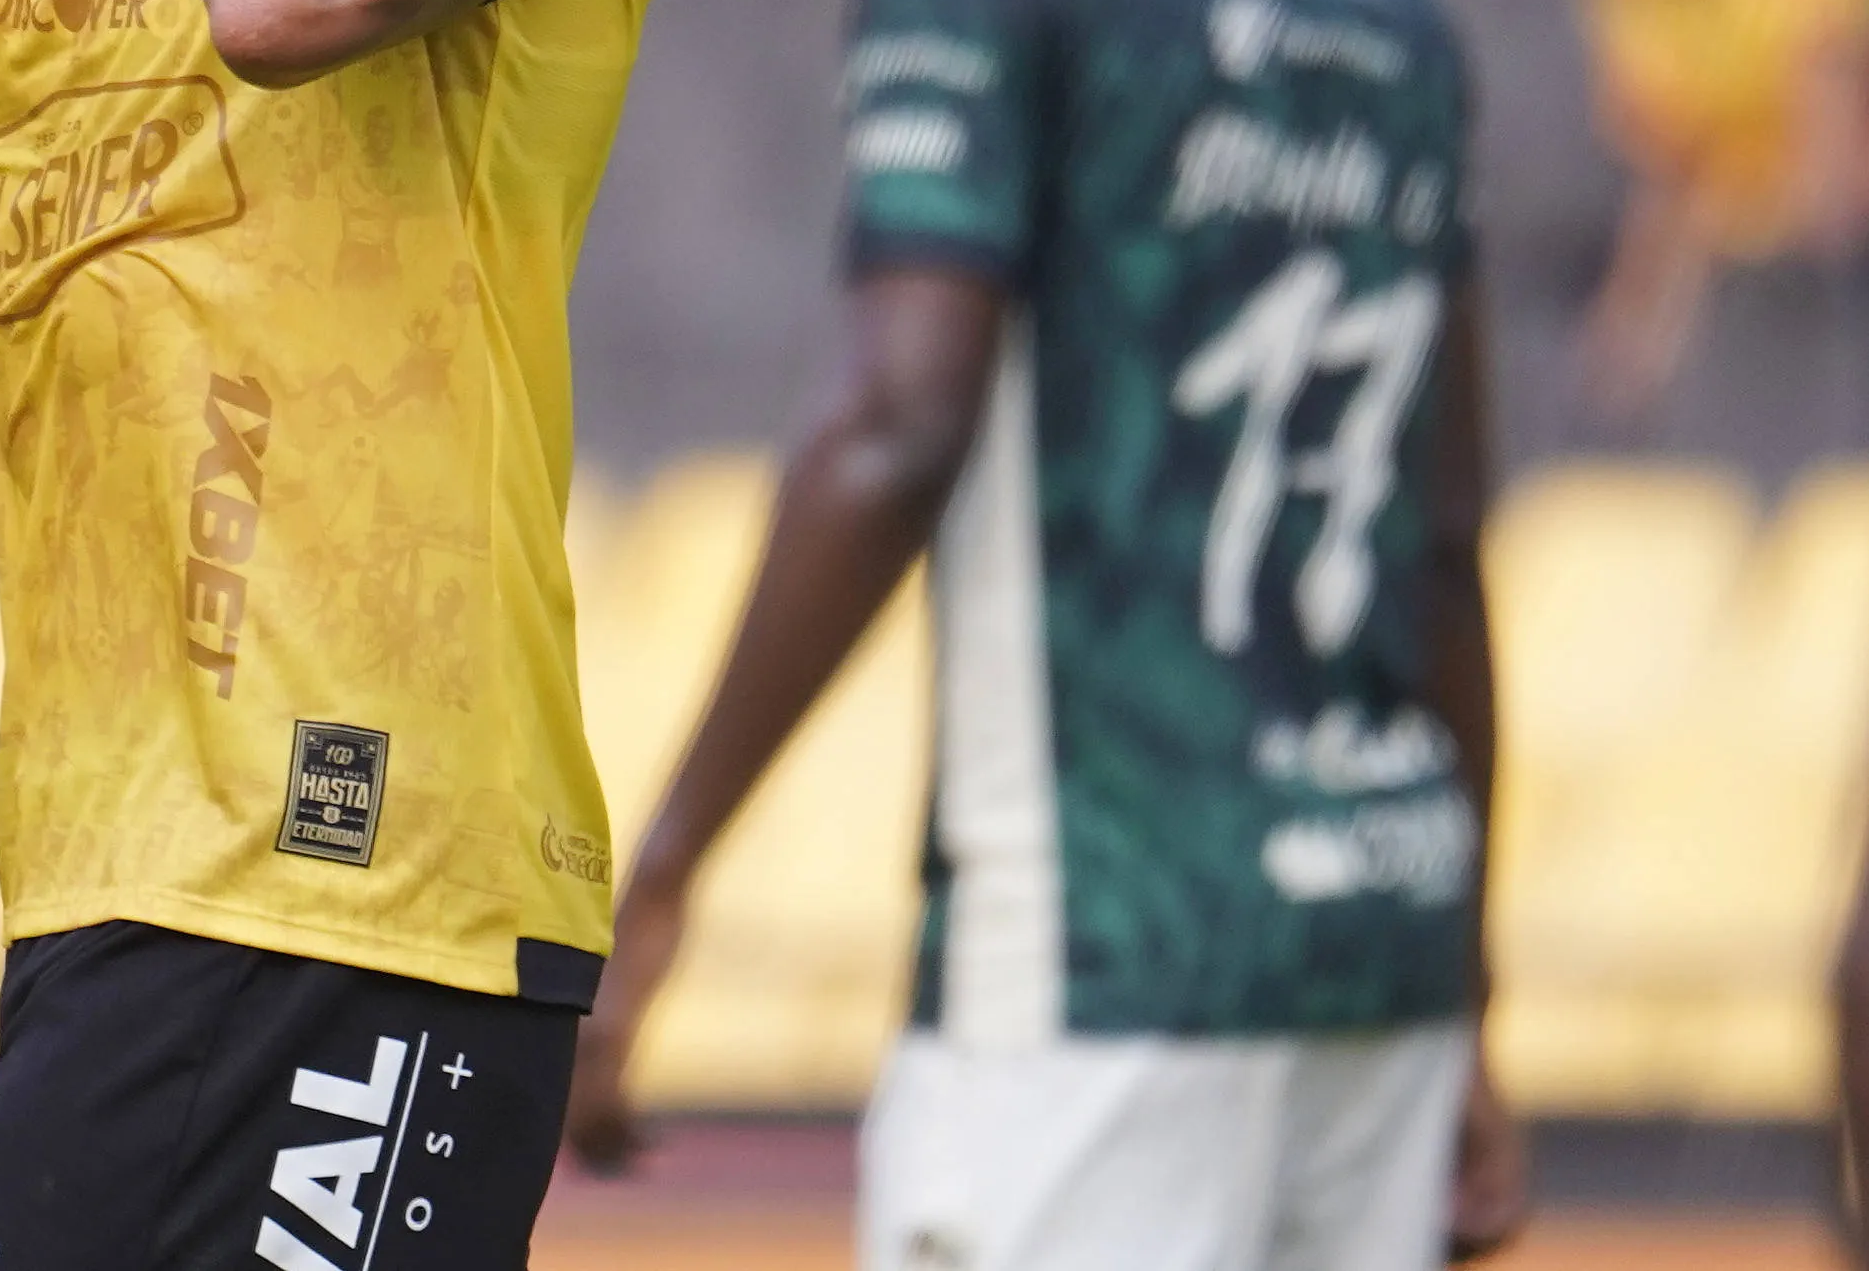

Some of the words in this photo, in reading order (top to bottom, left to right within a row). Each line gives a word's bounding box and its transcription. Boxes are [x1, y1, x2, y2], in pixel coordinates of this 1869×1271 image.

[185, 372, 272, 702] 1XBET
[1170, 248, 1442, 660] 17
[299, 772, 370, 810] HASTA
